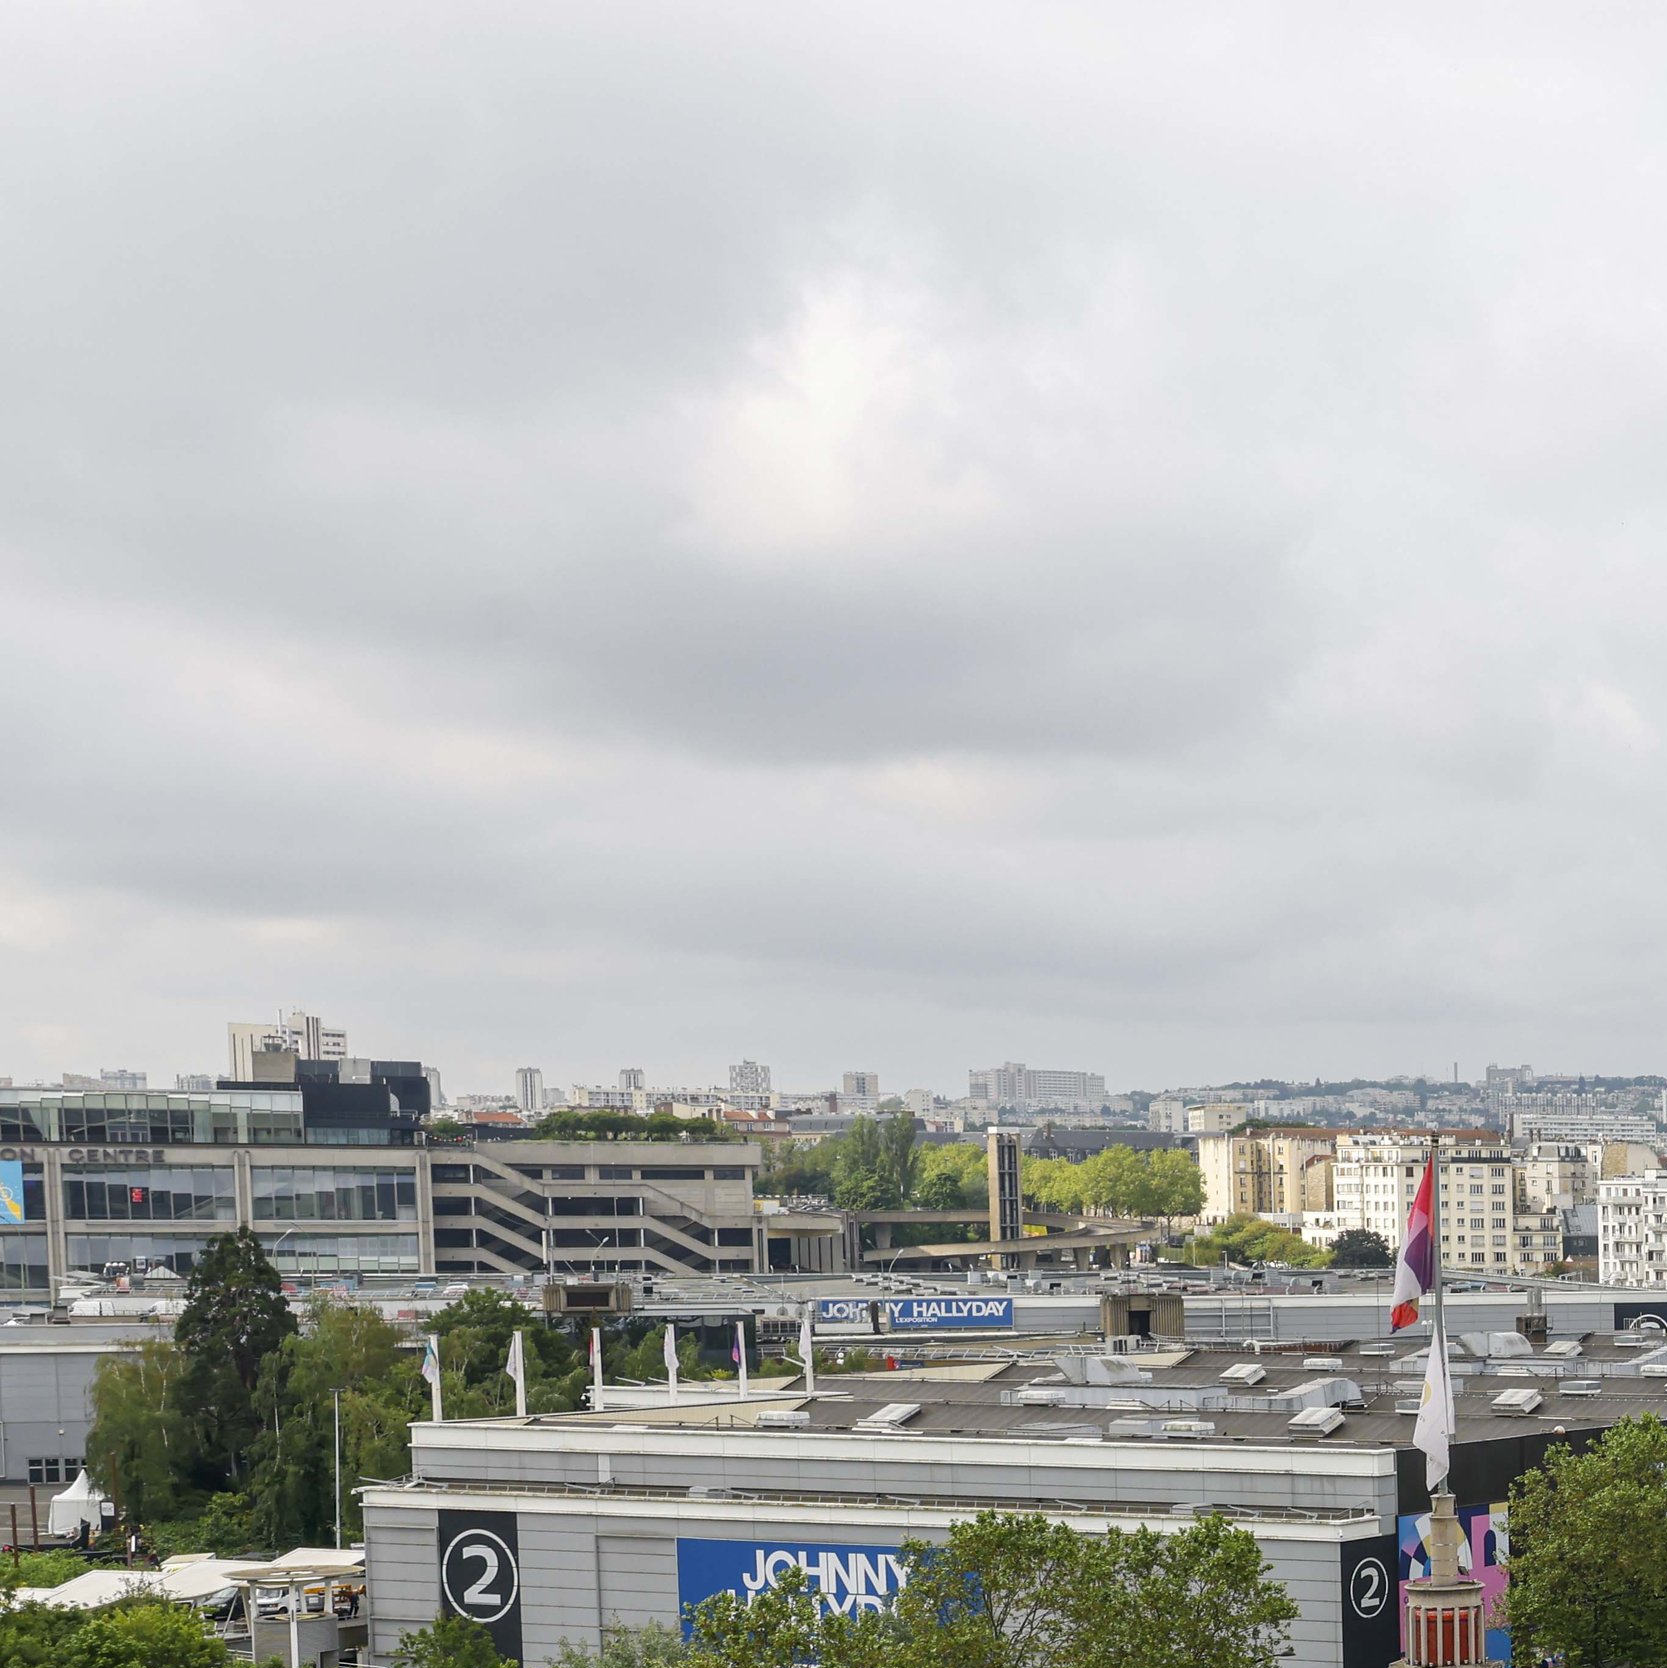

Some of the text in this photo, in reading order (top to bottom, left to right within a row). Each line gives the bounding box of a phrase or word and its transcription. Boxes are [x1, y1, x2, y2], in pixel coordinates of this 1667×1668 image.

[68, 1148, 165, 1163] CENTRE
[913, 1301, 1008, 1317] HALLYDAY
[464, 1544, 501, 1606] 2
[742, 1549, 917, 1595] JOHNNY
[1360, 1569, 1380, 1608] 2
